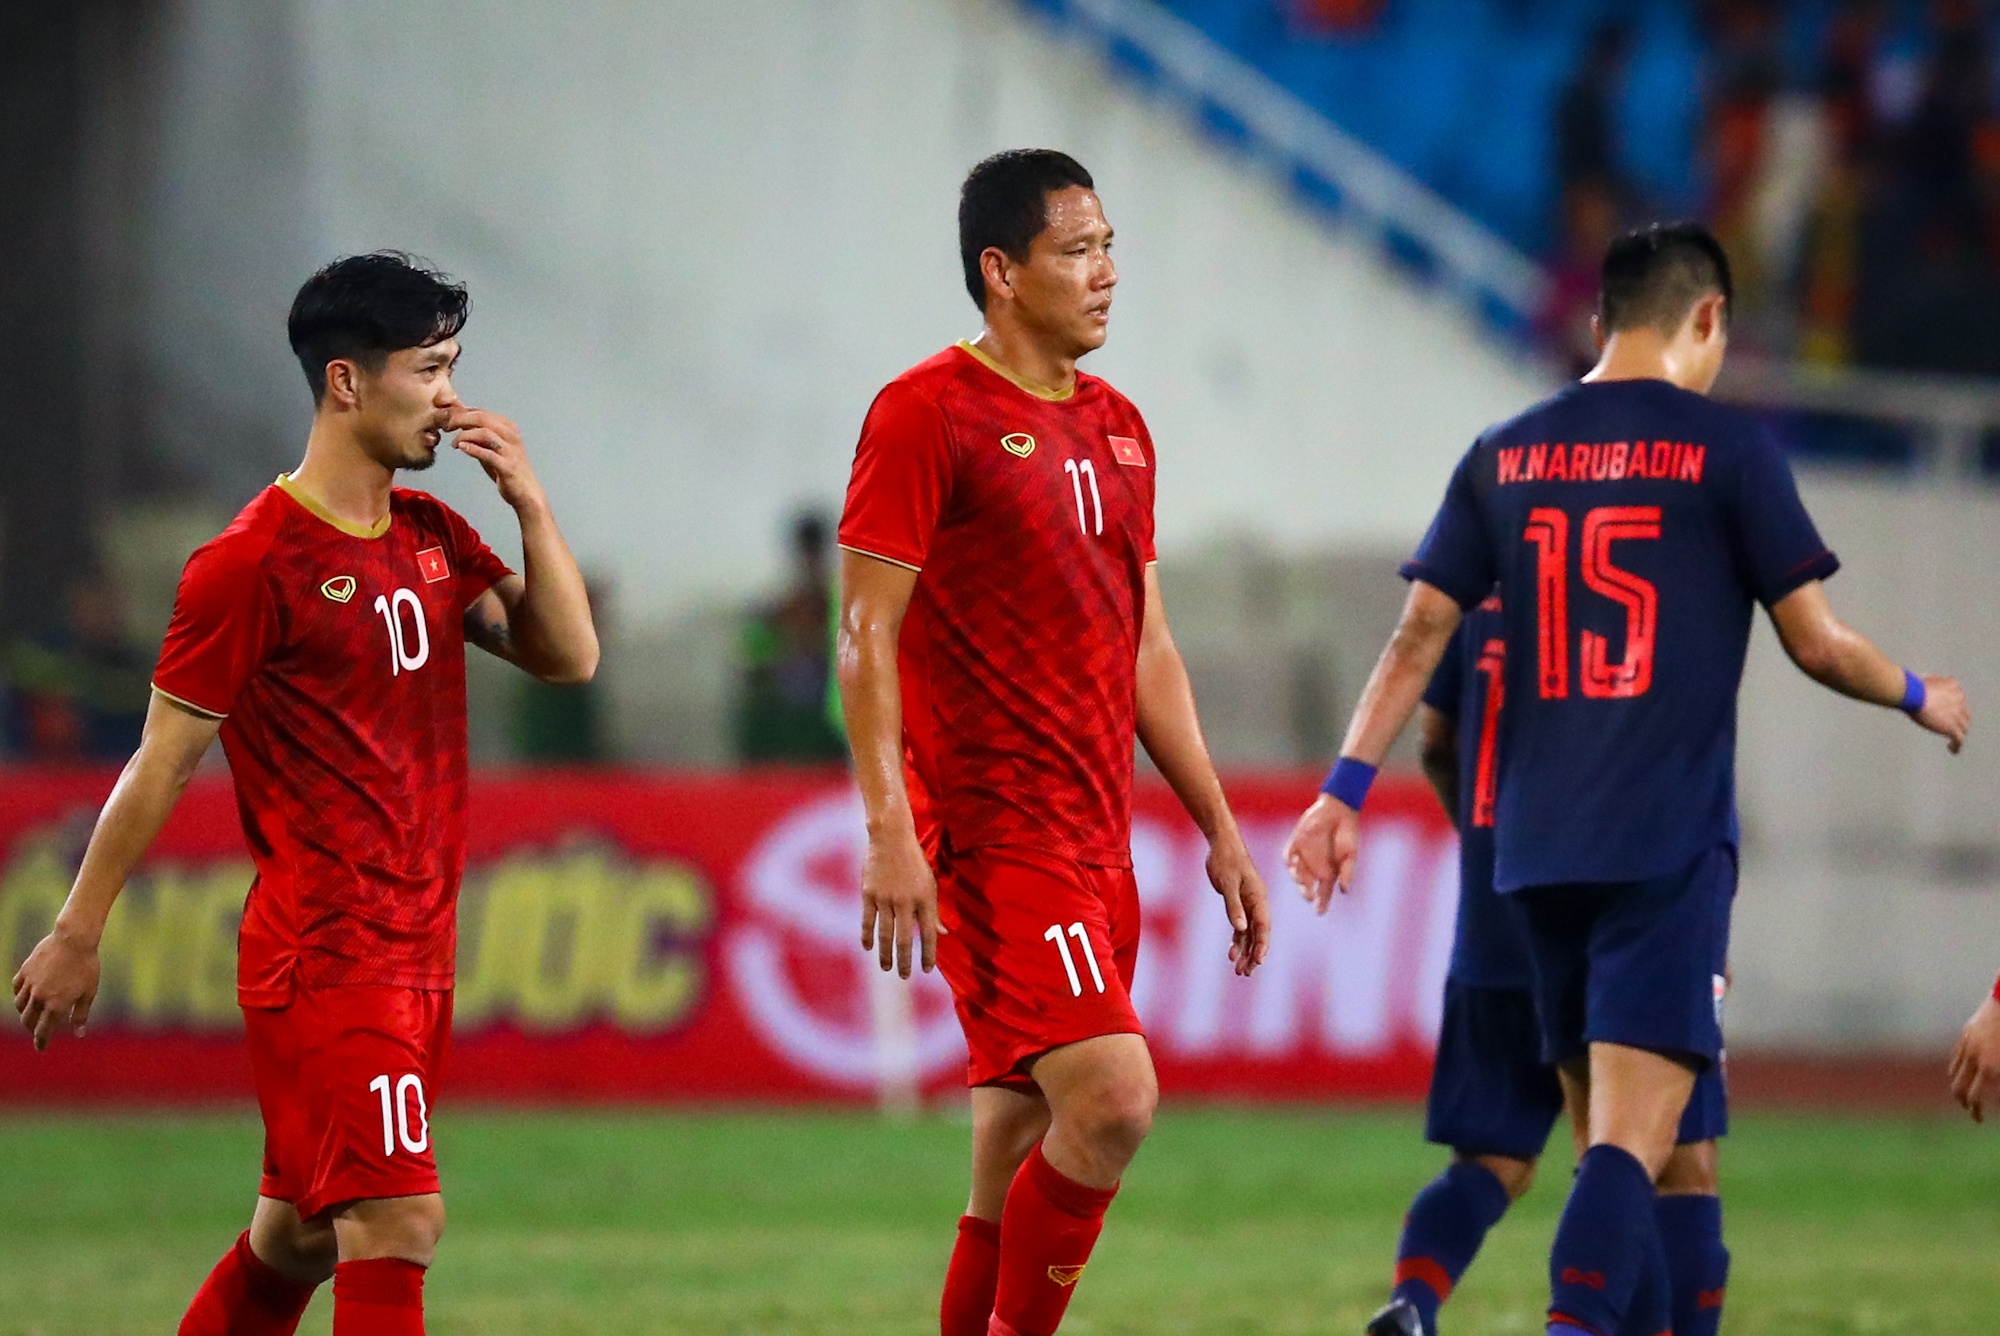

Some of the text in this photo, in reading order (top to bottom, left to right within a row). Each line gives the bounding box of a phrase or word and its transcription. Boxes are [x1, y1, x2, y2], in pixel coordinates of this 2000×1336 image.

[1063, 458, 1104, 536] 11
[1497, 440, 1706, 484] W.NARUBADIN
[373, 587, 430, 677] 10
[1523, 505, 1662, 700] 15
[1043, 920, 1105, 998] 11
[369, 1073, 429, 1157] 10
